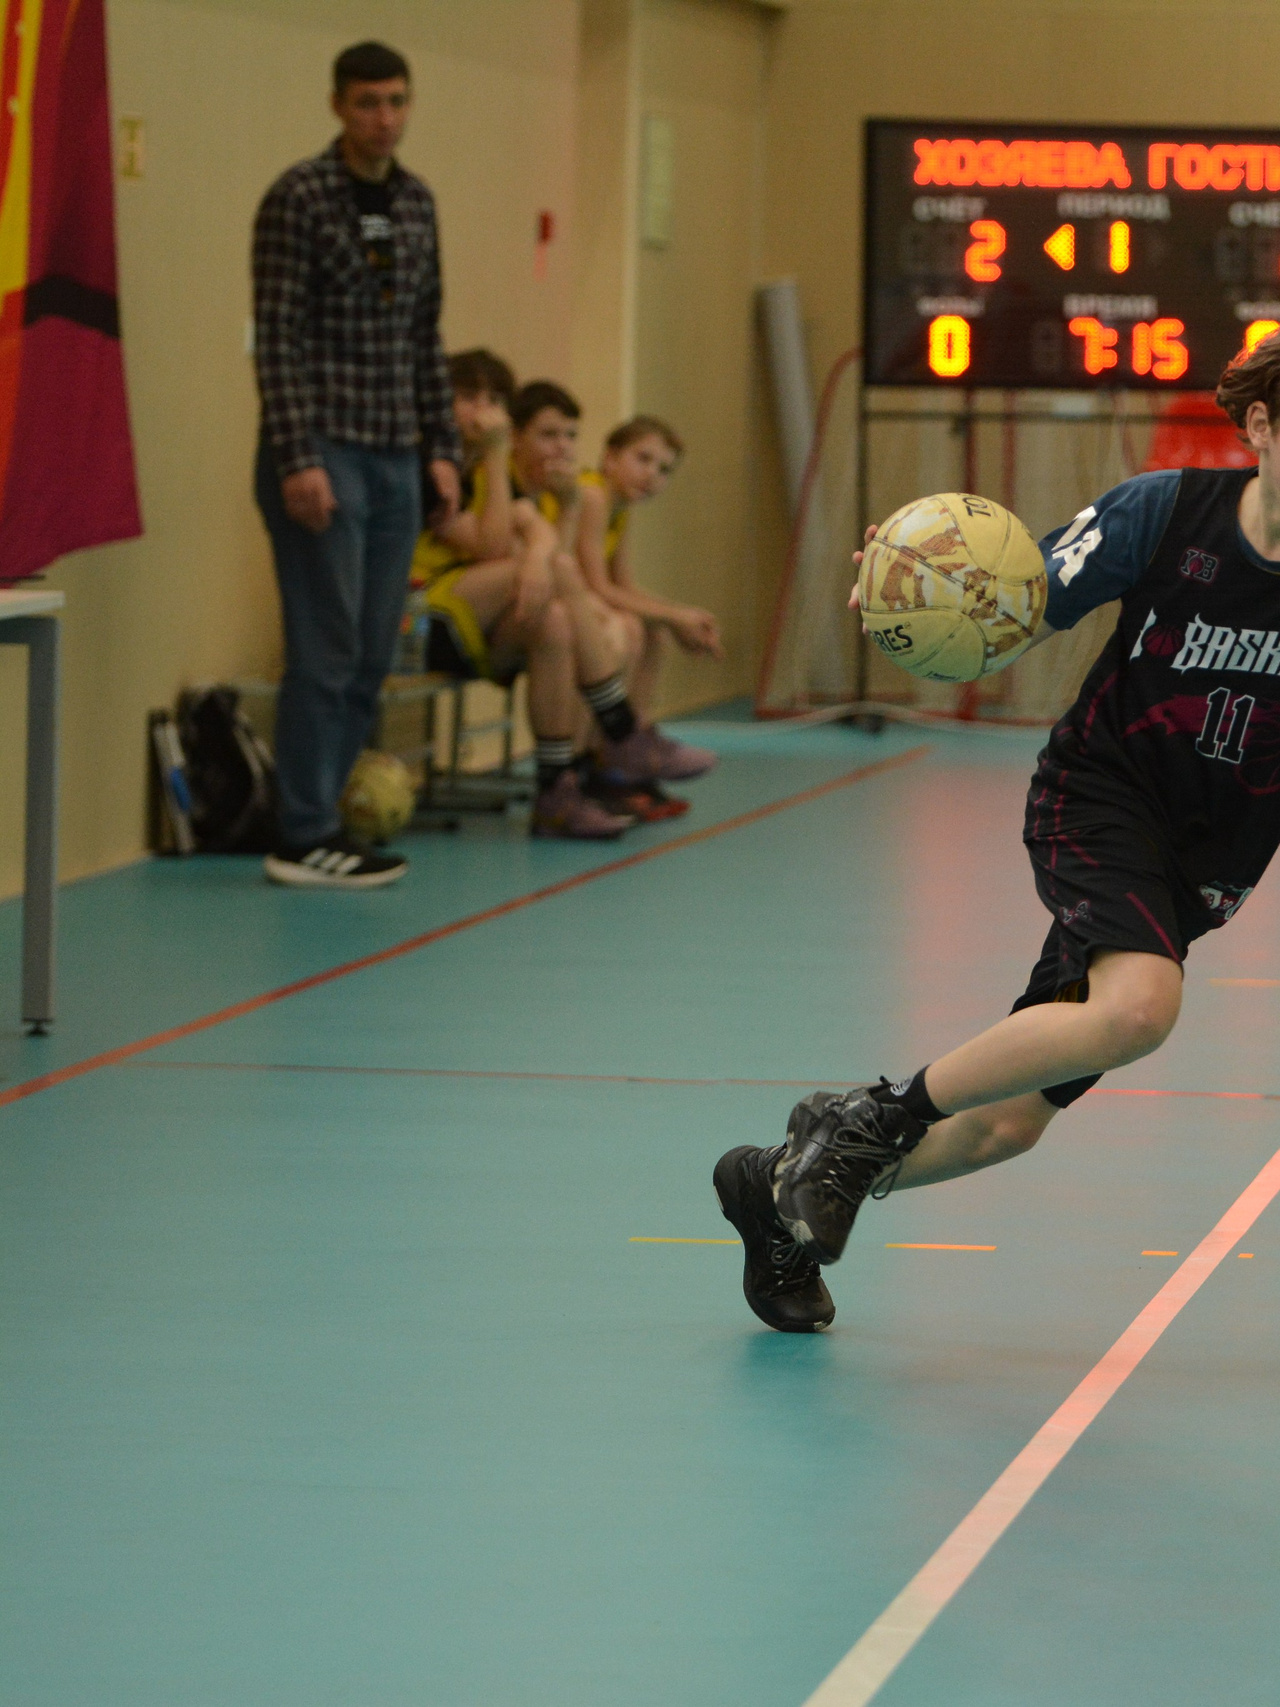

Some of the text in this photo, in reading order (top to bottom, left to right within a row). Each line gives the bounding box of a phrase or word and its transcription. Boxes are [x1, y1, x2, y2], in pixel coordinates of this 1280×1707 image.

[913, 138, 1132, 189] ХОЗЯЕВА
[965, 219, 1007, 283] 2
[1109, 220, 1131, 274] 1
[928, 314, 971, 377] 0
[1194, 686, 1256, 765] 11
